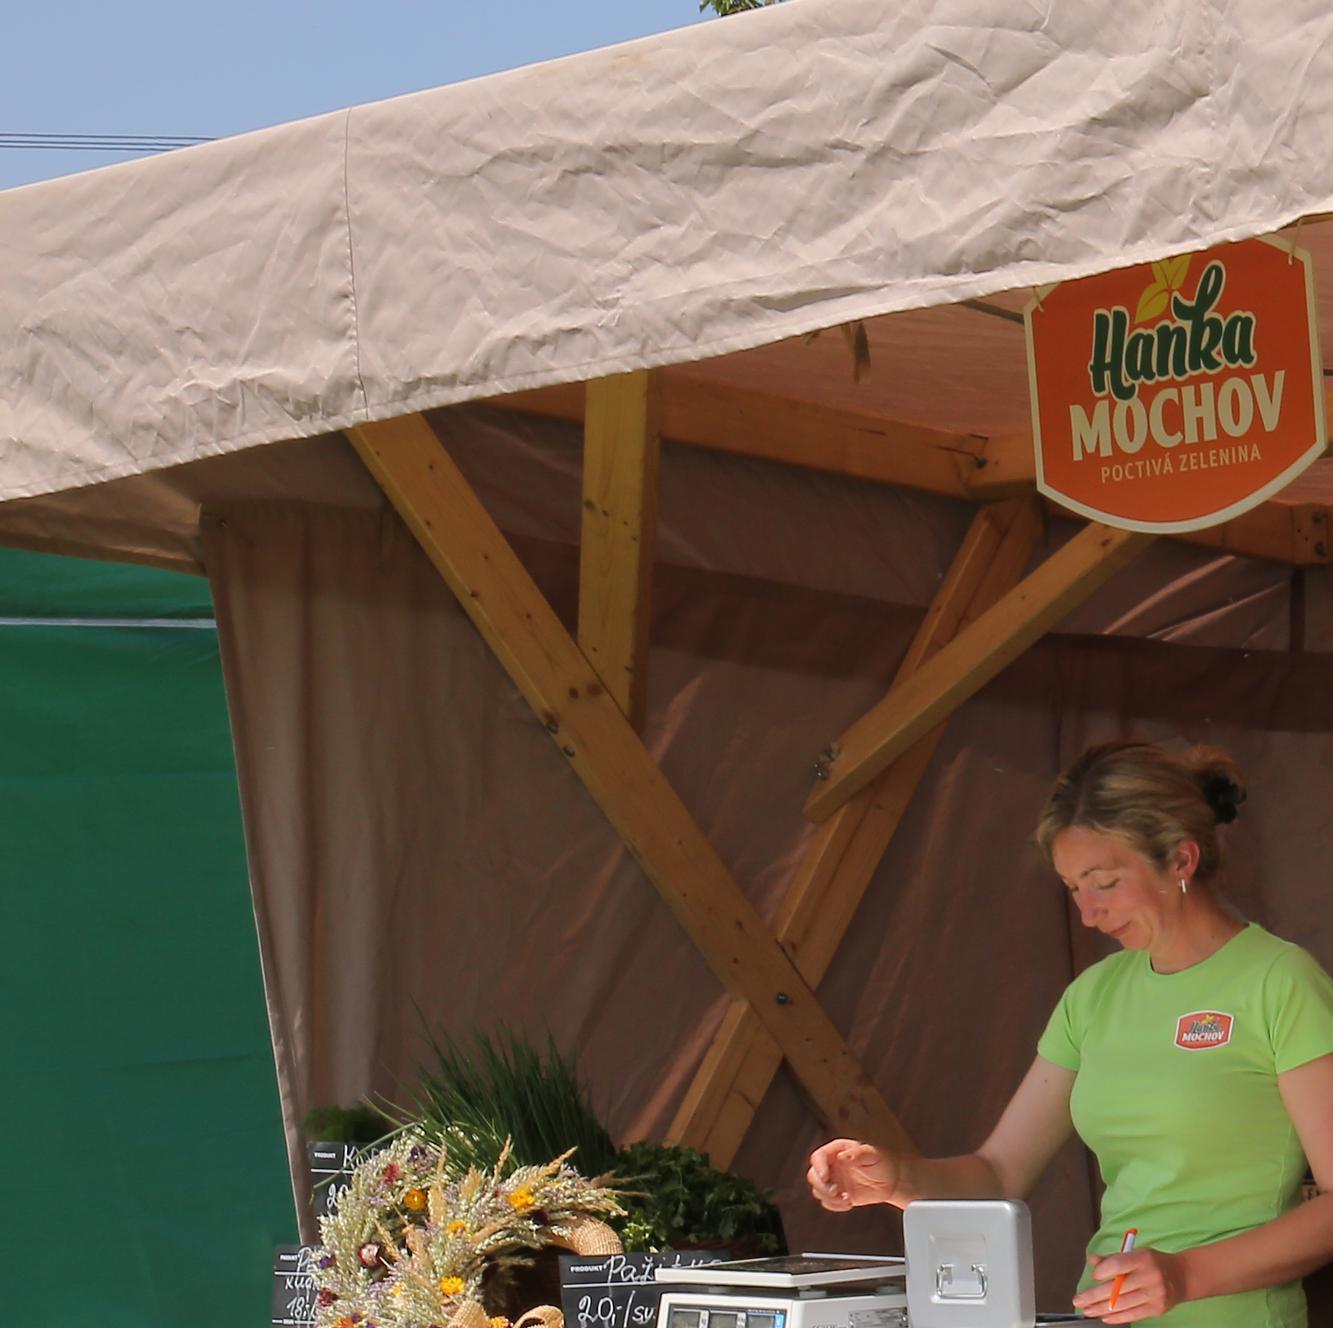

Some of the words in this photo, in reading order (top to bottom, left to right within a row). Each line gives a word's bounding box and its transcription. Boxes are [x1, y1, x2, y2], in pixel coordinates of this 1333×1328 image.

[1089, 259, 1256, 400] Hanka
[1069, 370, 1285, 461] MOCHOV
[1101, 448, 1174, 483] POCTIVÁ
[1179, 443, 1262, 472] ZELENINA
